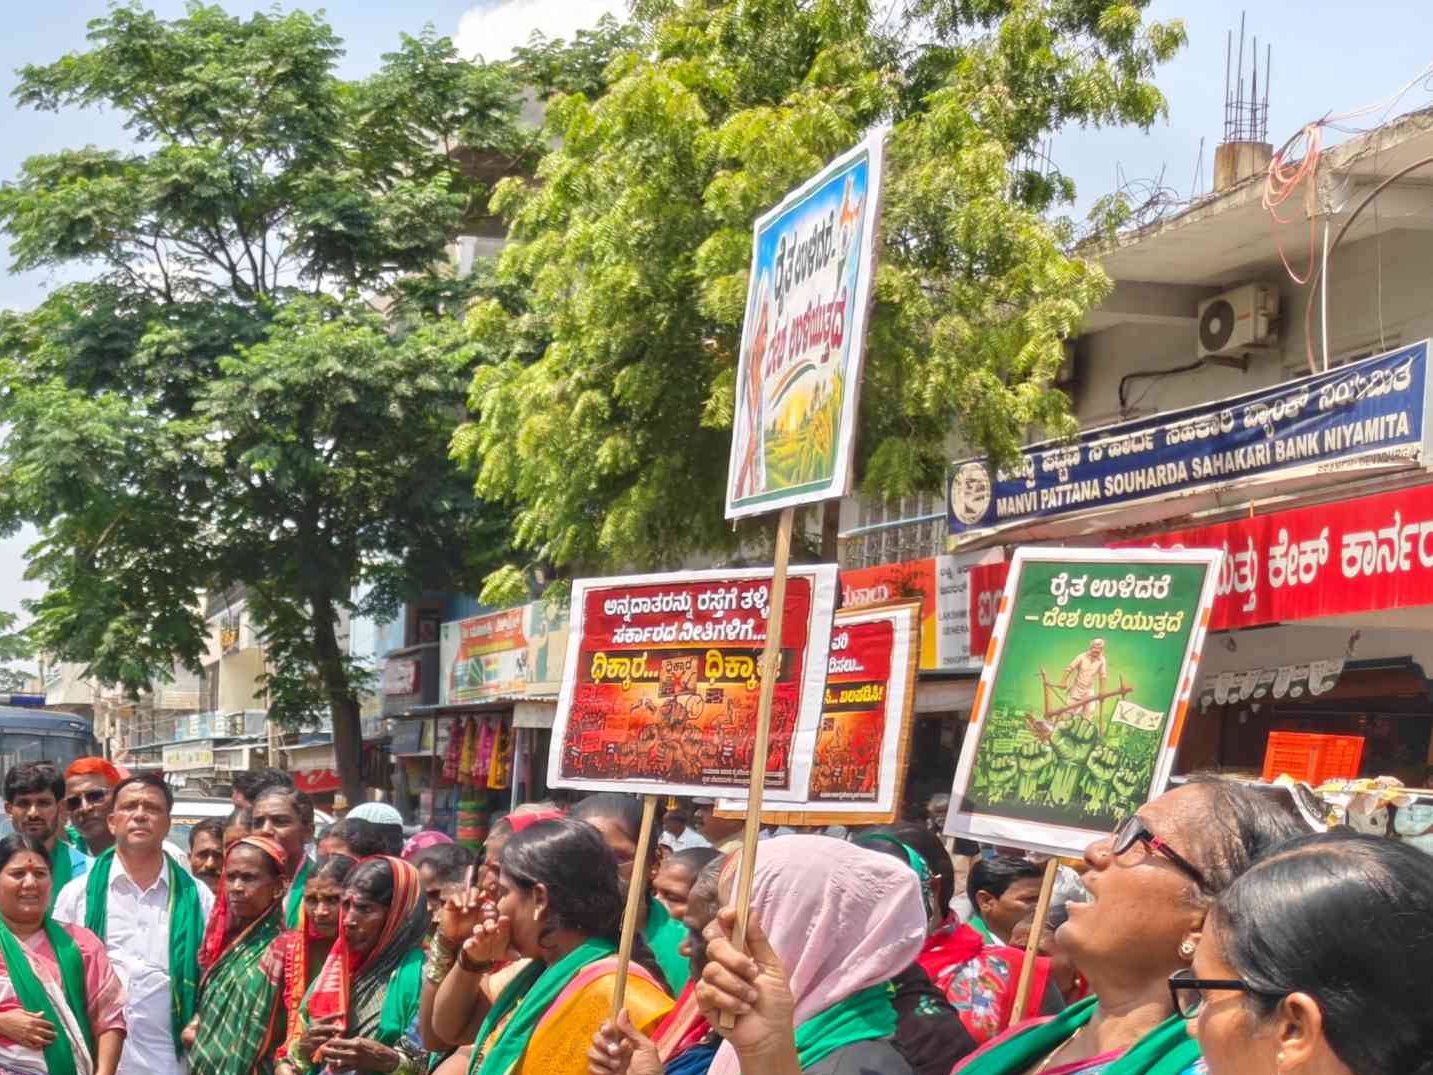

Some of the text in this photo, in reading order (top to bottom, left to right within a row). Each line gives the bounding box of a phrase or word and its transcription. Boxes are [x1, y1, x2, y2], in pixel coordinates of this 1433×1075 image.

[996, 490, 1038, 517] MANVI
[1041, 479, 1101, 510] PATTANA
[1104, 460, 1190, 497] SOUHARDA
[1191, 443, 1271, 479] SAHAKARI
[1275, 431, 1319, 461] BANK
[1324, 411, 1410, 451] NIYAMITA
[1268, 526, 1329, 588] ಕೇಕ್
[604, 591, 694, 622] ಅನ್ನದಾತರನ್ನು
[697, 587, 738, 618] ರಸ್ತೆಗೆ
[1051, 572, 1171, 604] ರೈತ ಉಳಿದರೆ
[612, 620, 678, 644] ಸರ್ಕಾರದ
[1042, 607, 1082, 628] ದೇಶ
[1083, 610, 1184, 640] ಉಳಿಯುತ್ತದೆ
